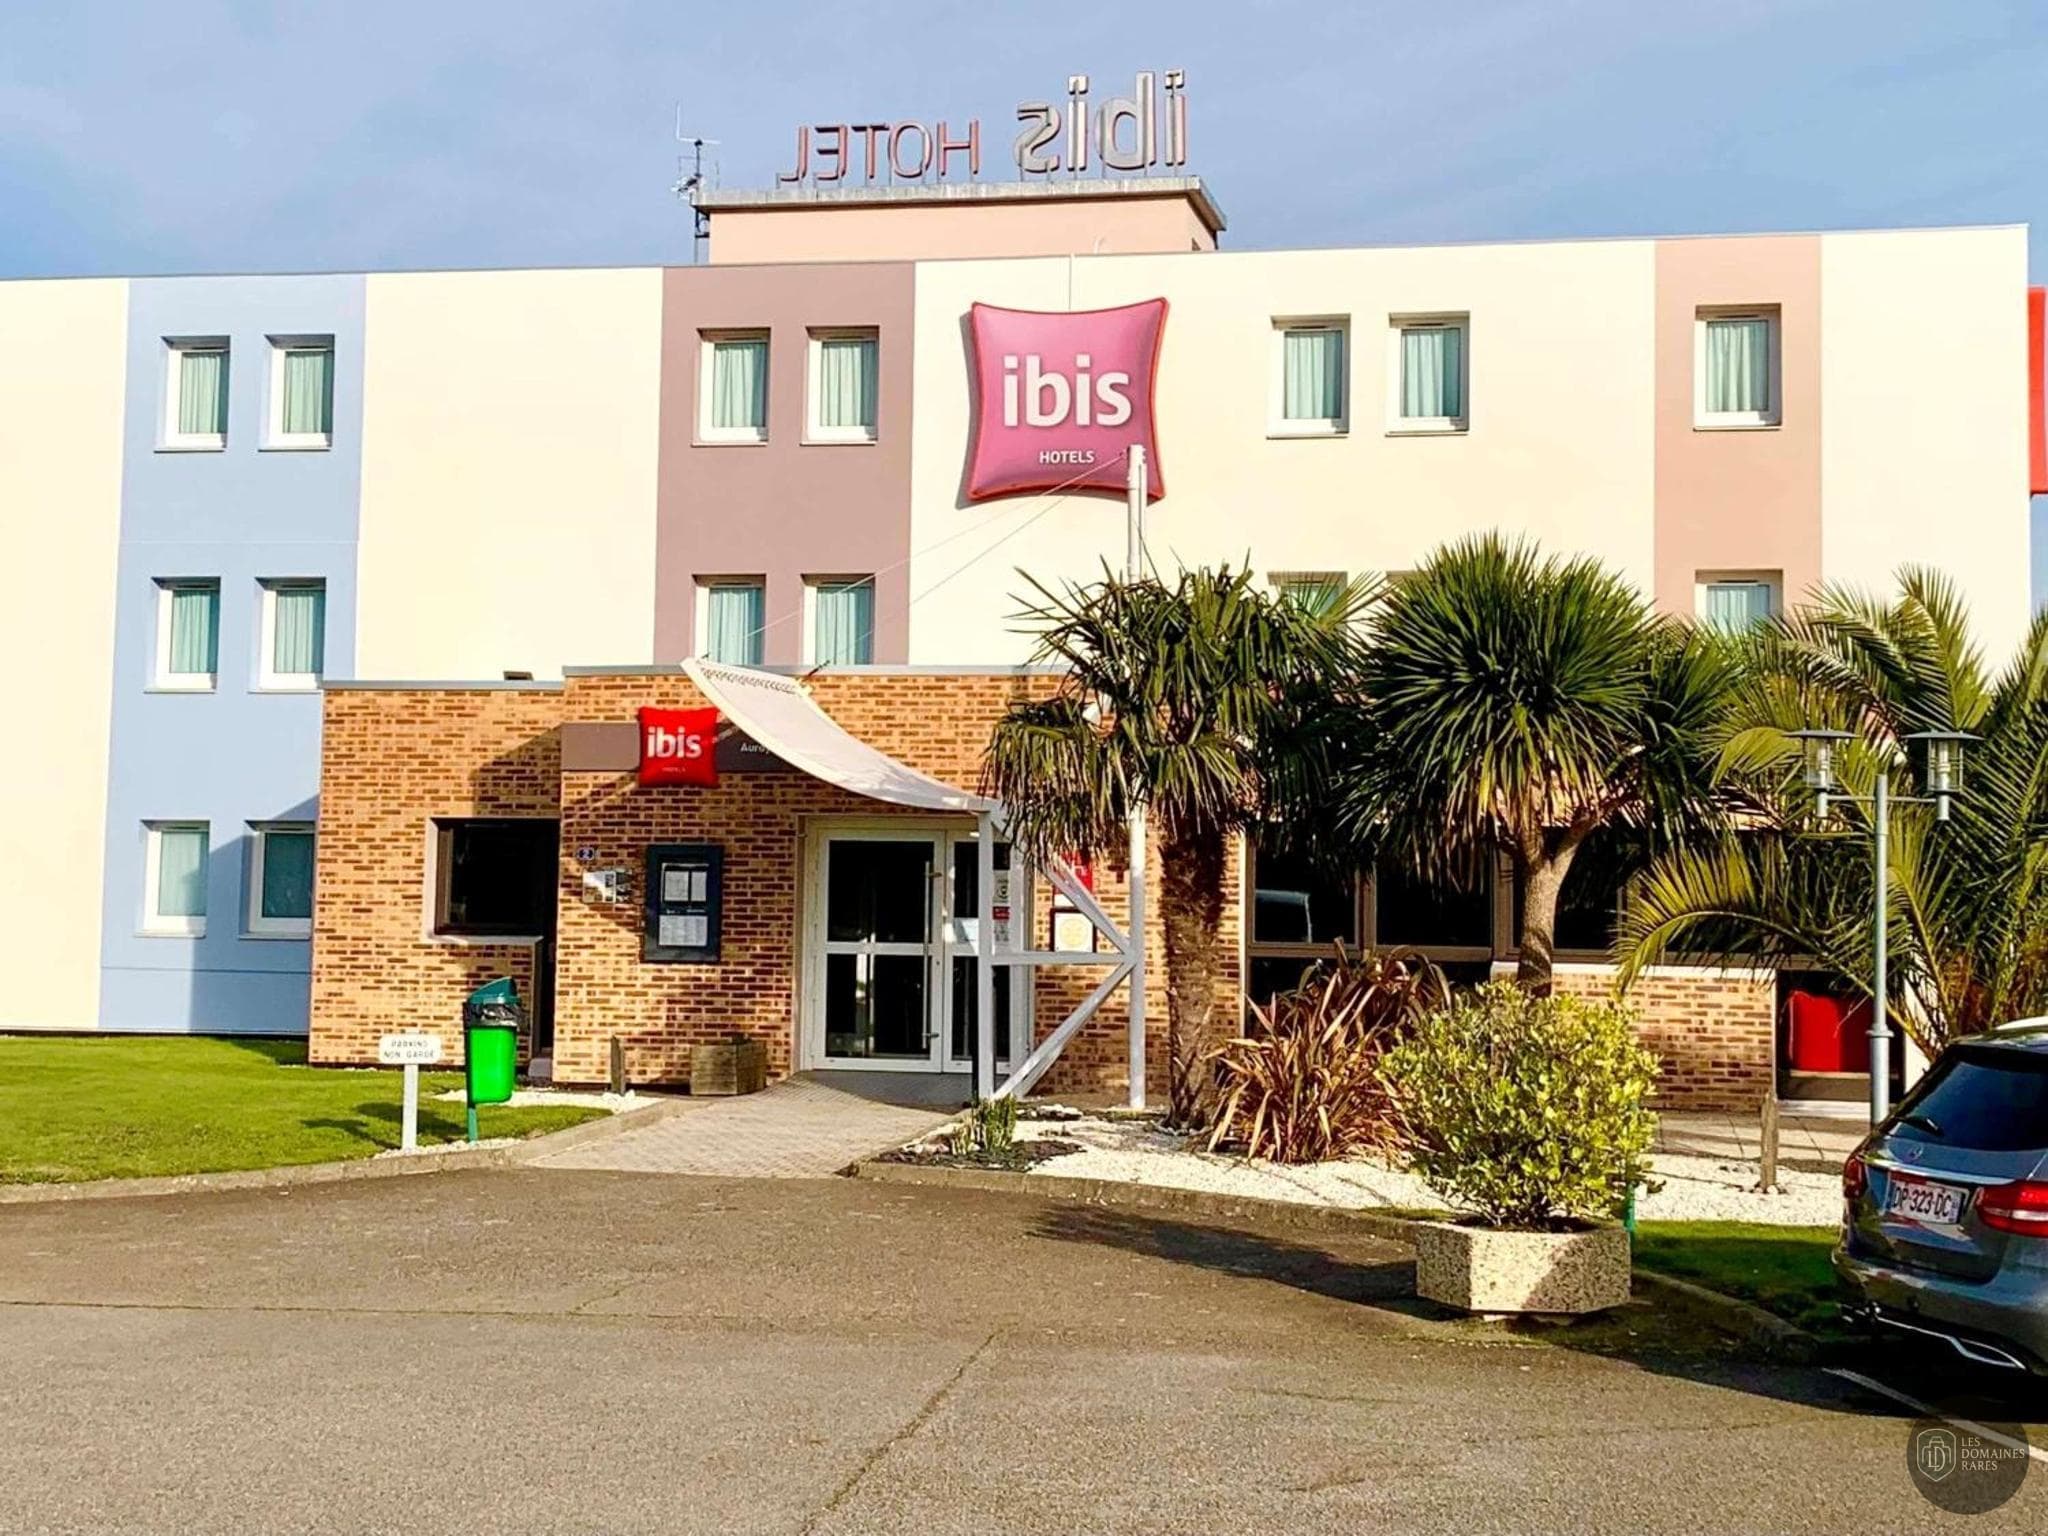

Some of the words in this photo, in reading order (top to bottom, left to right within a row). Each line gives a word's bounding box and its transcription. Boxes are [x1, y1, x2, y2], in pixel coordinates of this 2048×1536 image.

[1003, 353, 1132, 427] ibis
[1039, 450, 1095, 464] HOTELS
[647, 726, 702, 758] ibis
